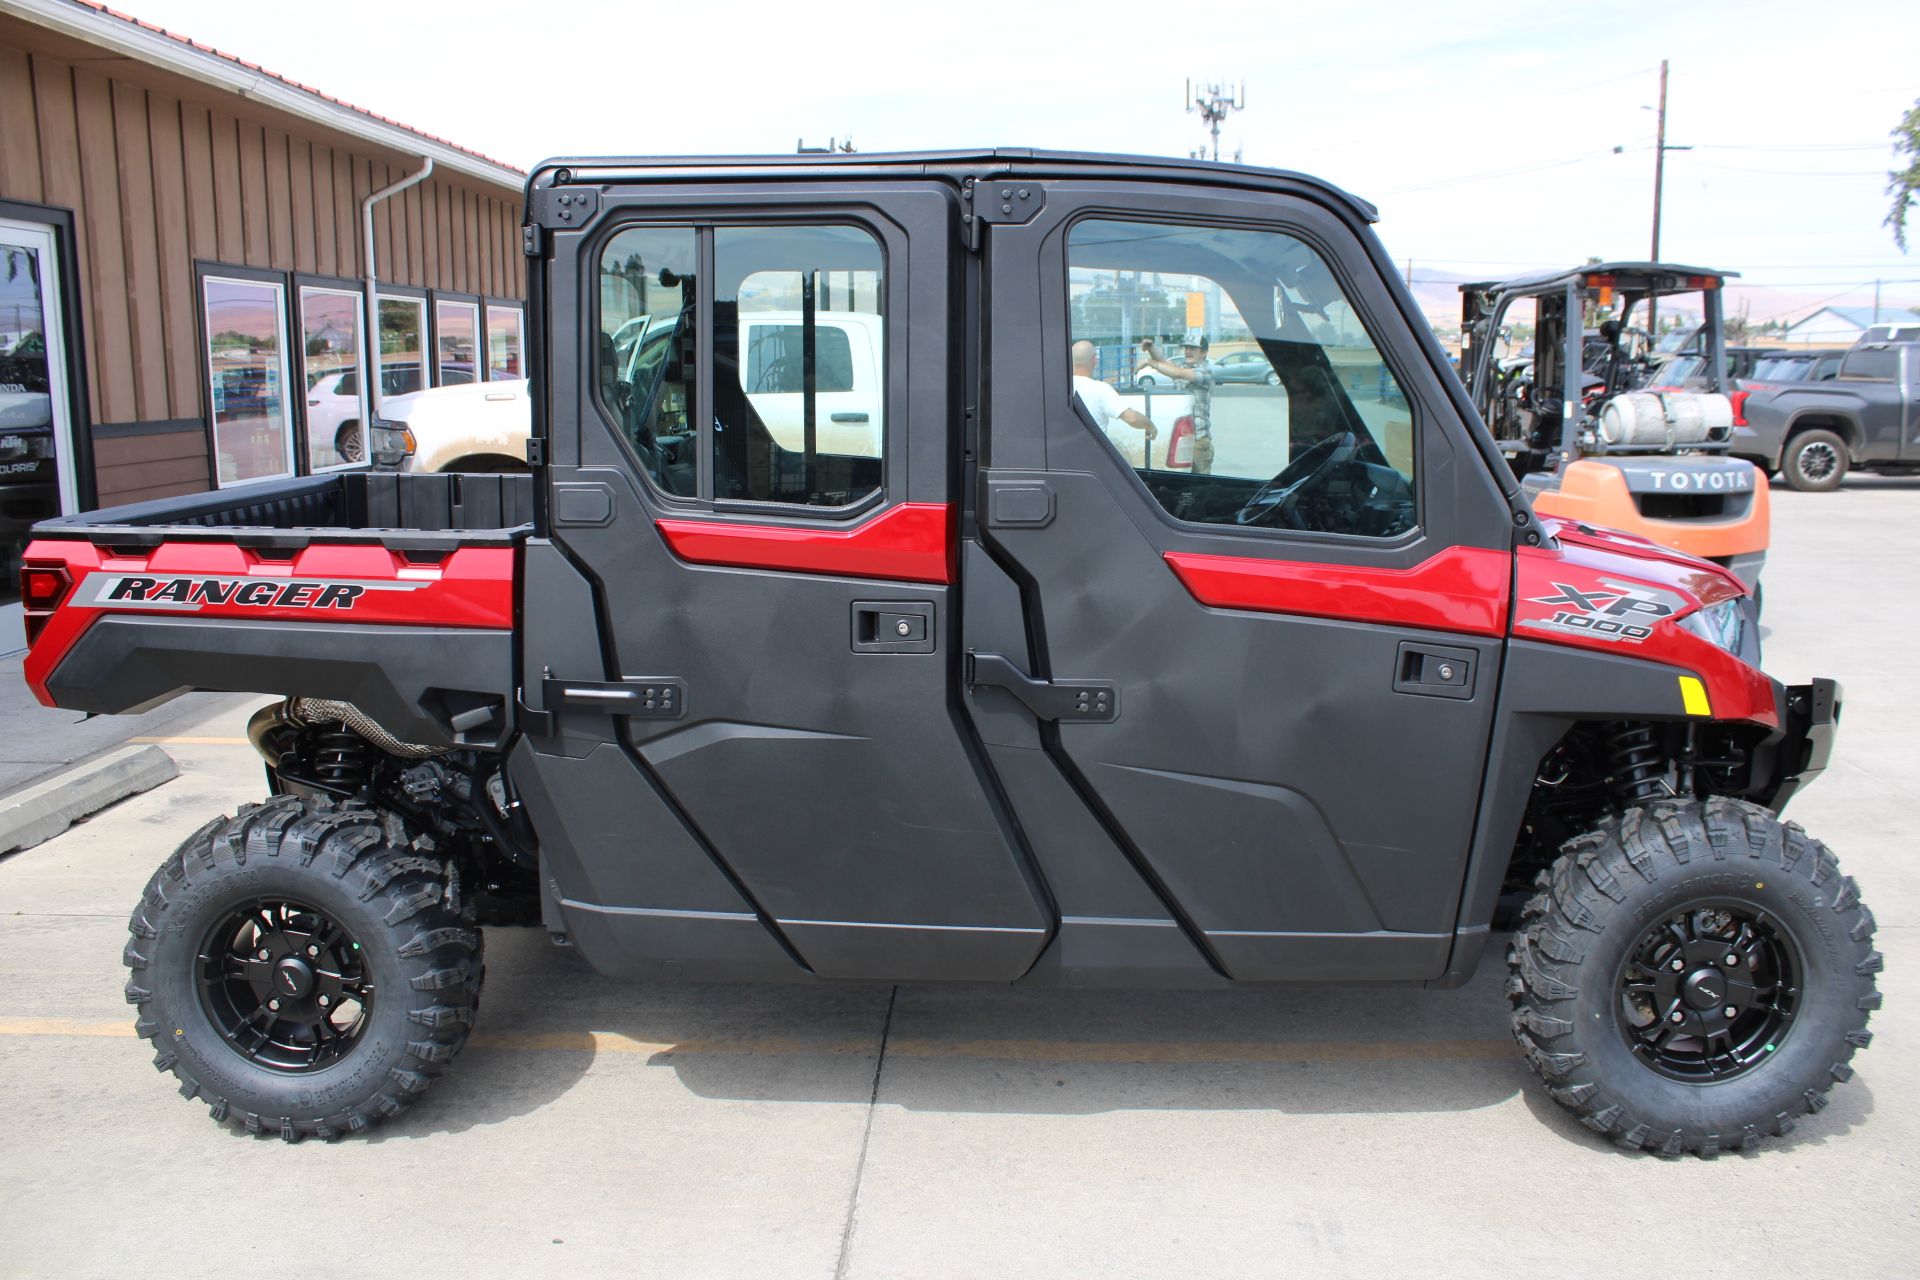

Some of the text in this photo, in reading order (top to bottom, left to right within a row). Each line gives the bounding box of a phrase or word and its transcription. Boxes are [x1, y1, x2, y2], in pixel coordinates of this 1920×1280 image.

[0, 383, 26, 392] NDA
[1651, 472, 1748, 488] TOYOTA
[107, 576, 366, 609] RANGER
[1524, 582, 1675, 616] XP
[1551, 611, 1653, 639] 1000
